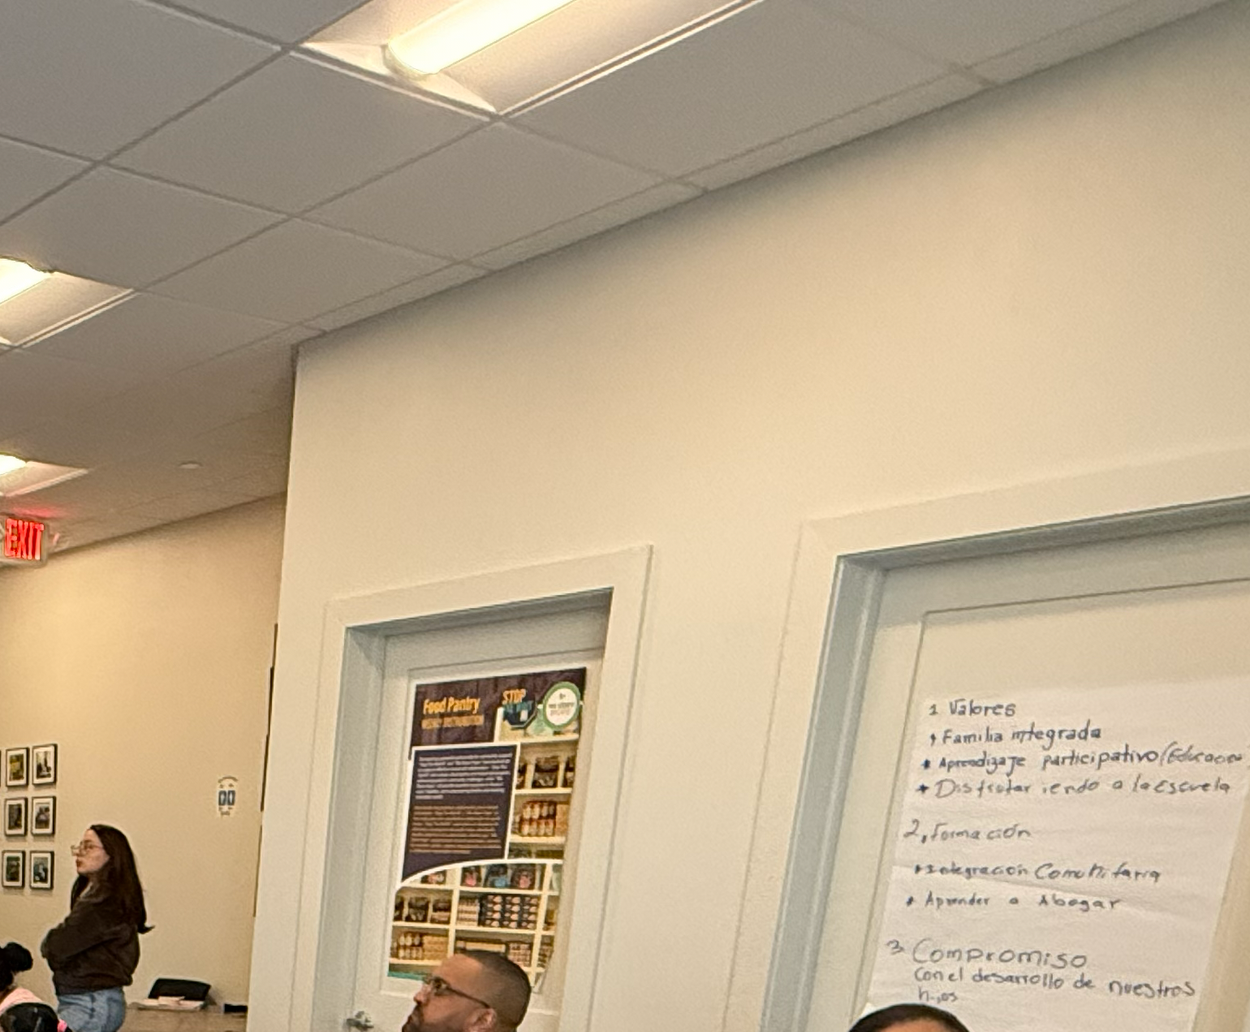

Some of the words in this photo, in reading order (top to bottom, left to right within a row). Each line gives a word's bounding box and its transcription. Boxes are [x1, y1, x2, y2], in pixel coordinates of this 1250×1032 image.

[4, 517, 45, 560] EXIT
[422, 698, 447, 716] Food
[448, 695, 481, 715] Pantry
[502, 688, 527, 705] STOP
[949, 698, 1017, 717] Valores
[942, 726, 1004, 745] Familia
[1038, 893, 1122, 913] Abogar
[912, 937, 1088, 969] Compromiso
[971, 968, 1064, 991] desarrollo
[1072, 973, 1096, 990] de
